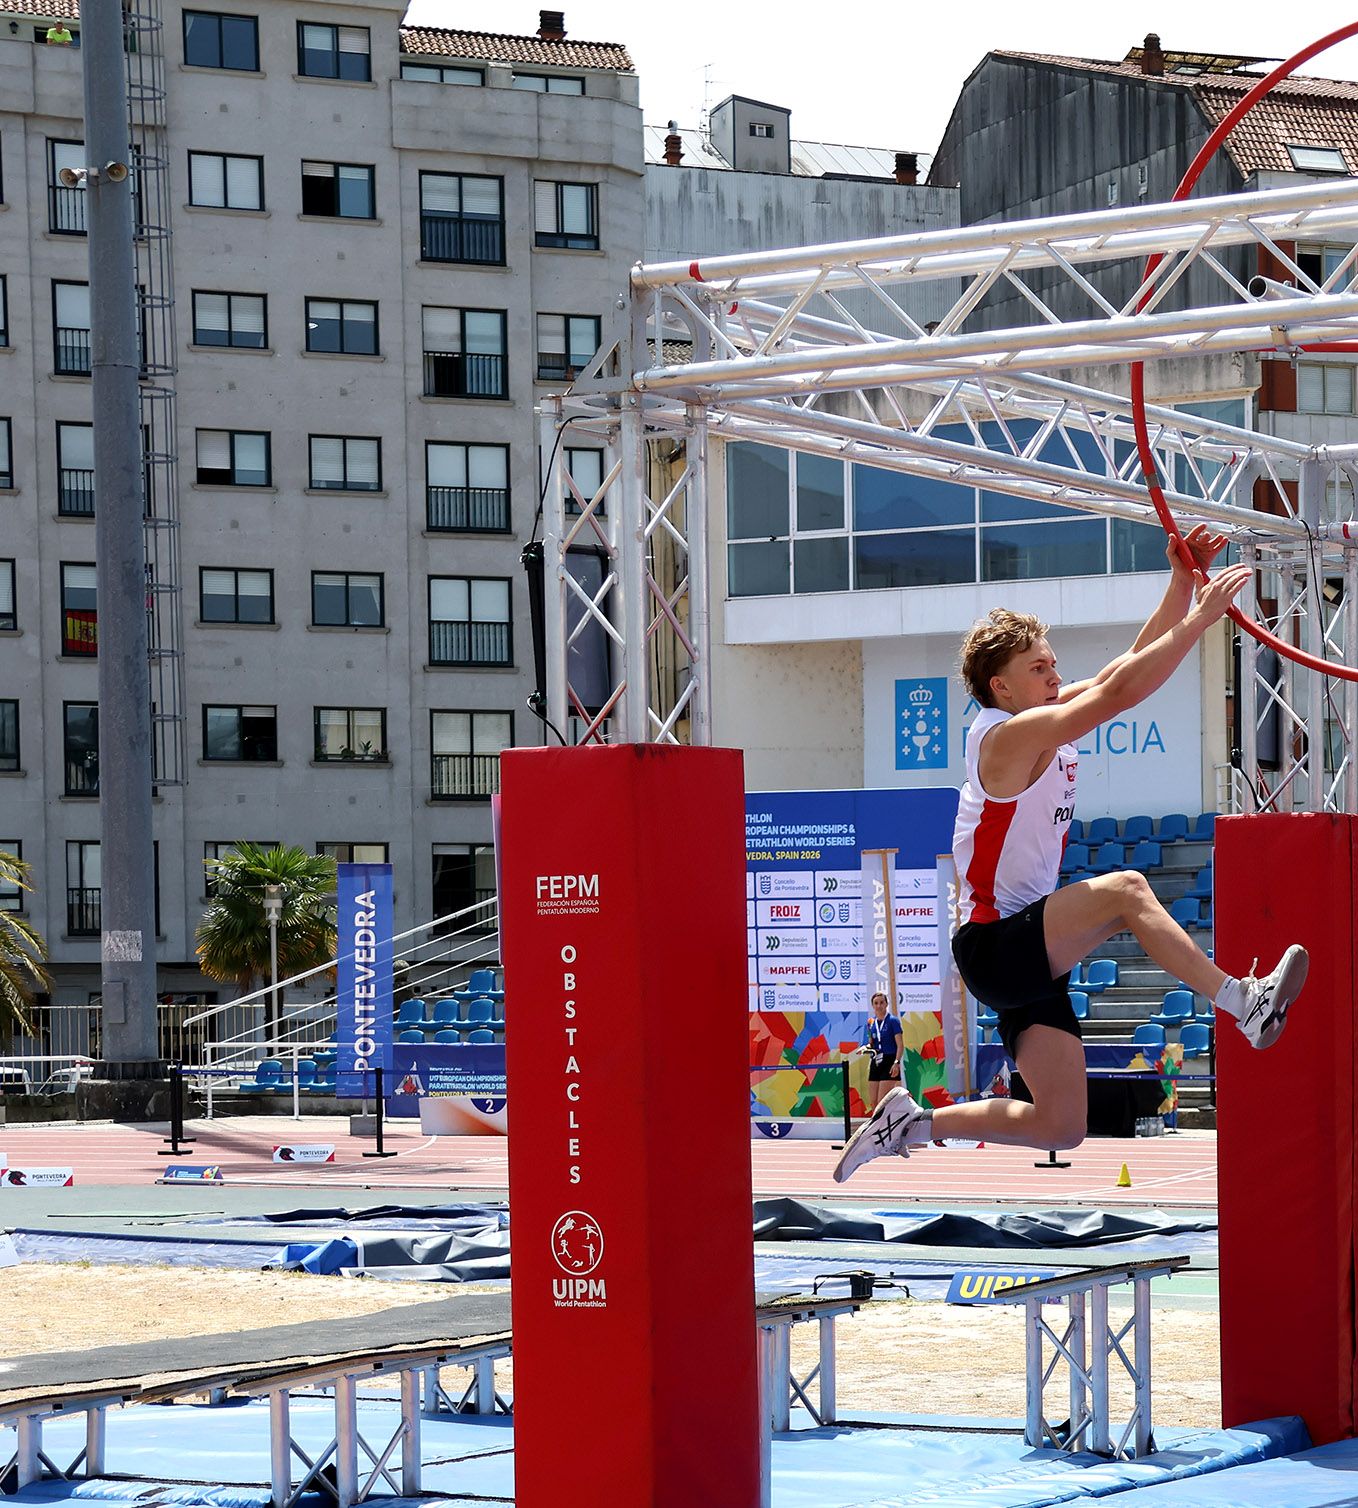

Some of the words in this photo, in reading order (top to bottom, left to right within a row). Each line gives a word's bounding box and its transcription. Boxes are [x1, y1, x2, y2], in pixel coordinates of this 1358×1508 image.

[1078, 721, 1165, 754] ICIA
[746, 825, 779, 836] ROPEAN
[779, 824, 848, 835] CHAMPIONSHIPS
[849, 824, 856, 834] &
[746, 838, 794, 848] ETRATHLON
[794, 837, 825, 847] WORLD
[826, 836, 856, 846] SERIES
[775, 851, 800, 860] SPAIN
[800, 850, 821, 859] 2026
[536, 874, 599, 899] FEPM
[537, 900, 570, 908] FEDERACIÓN
[571, 898, 599, 906] ESPAÑOLA
[568, 906, 600, 915] MODERNO
[770, 905, 800, 917] FROIZ
[769, 966, 811, 975] MAPFRE
[353, 890, 376, 1072] PONTEVEDRA
[560, 945, 581, 1184] OBSTACLES
[485, 1099, 495, 1113] 2
[770, 1123, 780, 1137] 3
[552, 1279, 607, 1300] UIPM
[554, 1300, 574, 1308] World
